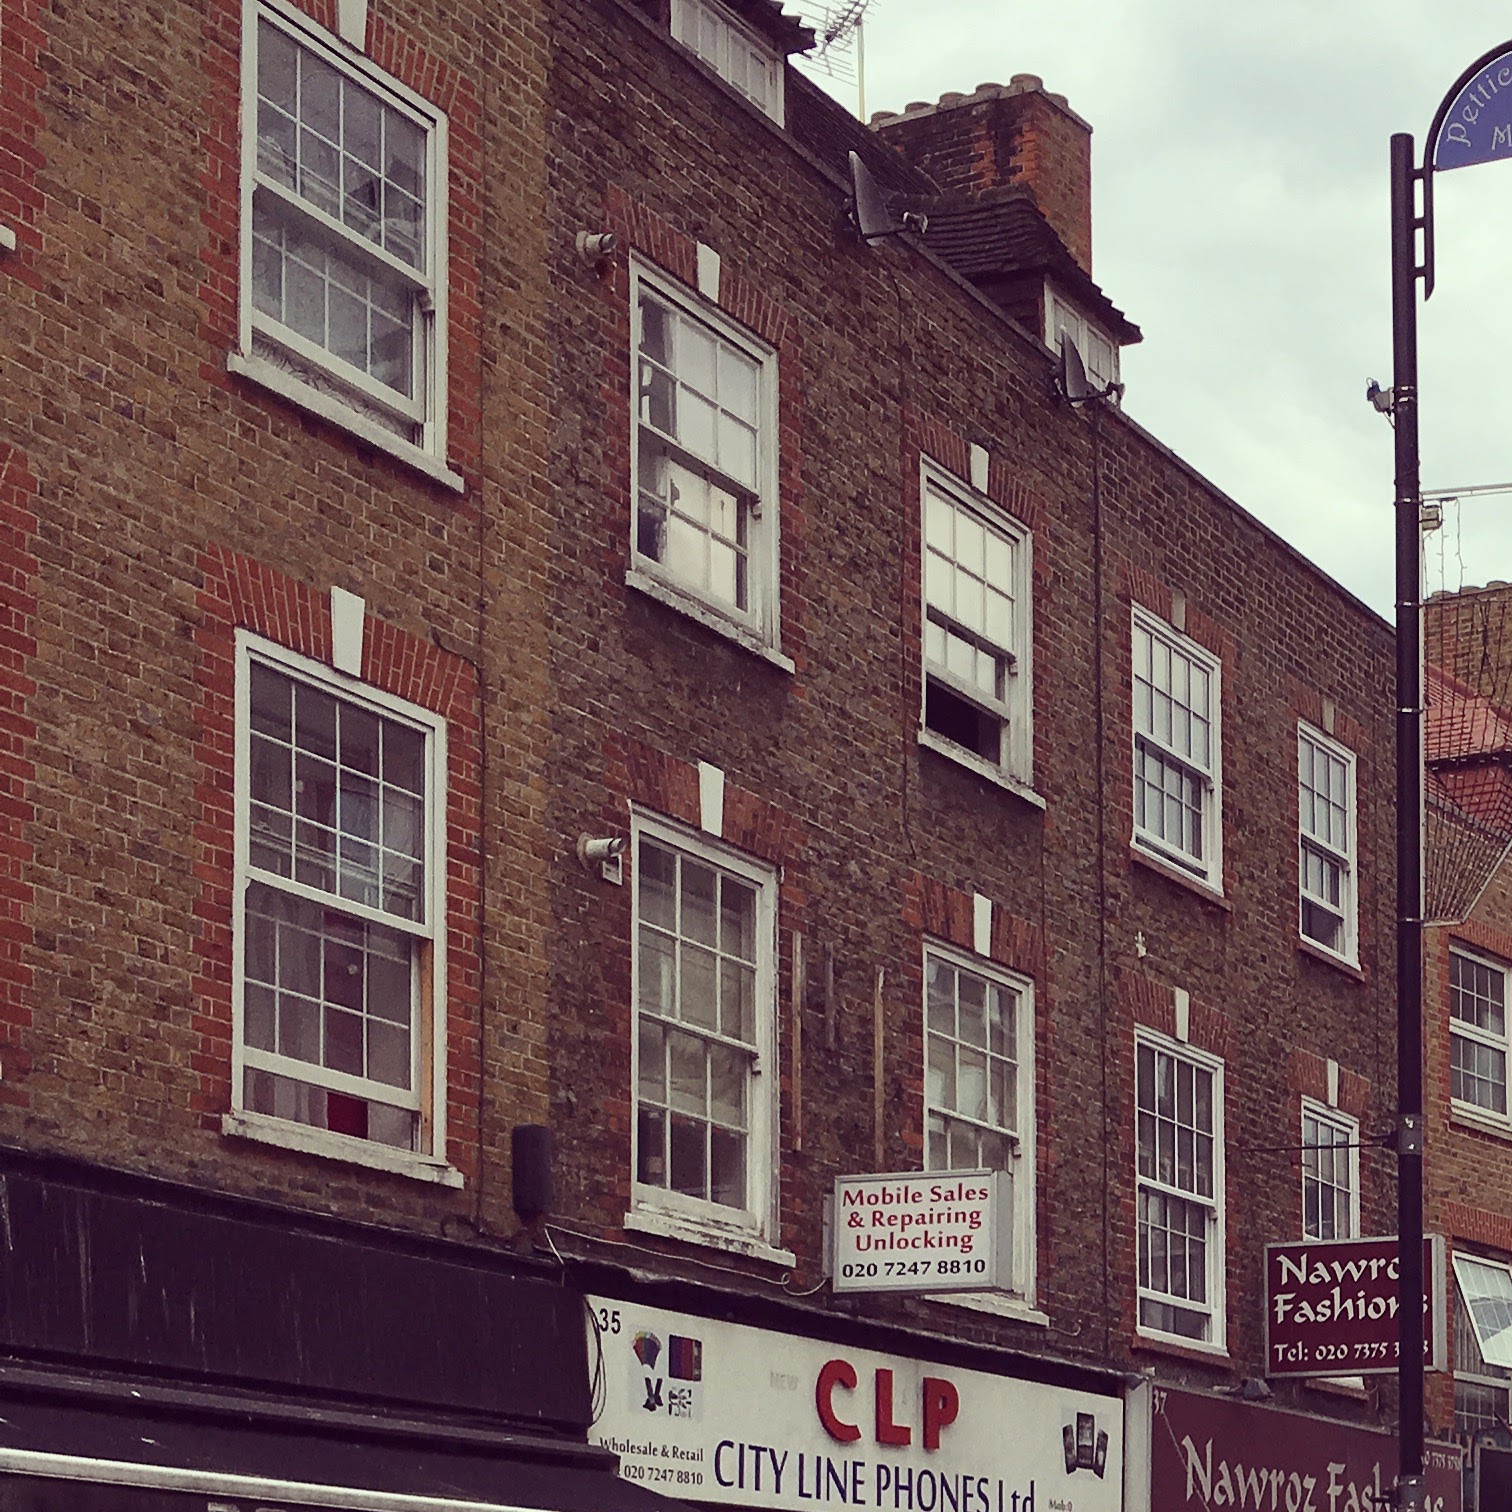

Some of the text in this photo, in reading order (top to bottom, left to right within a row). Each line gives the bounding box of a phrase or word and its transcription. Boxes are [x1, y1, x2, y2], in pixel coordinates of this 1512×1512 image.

[842, 1182, 989, 1207] Mobile Sales
[847, 1206, 982, 1233] & Repairing
[855, 1230, 974, 1254] Unlocking
[842, 1258, 986, 1278] 020 7247 8810
[1275, 1252, 1400, 1286] Nawro
[599, 1307, 622, 1335] 35
[1273, 1341, 1309, 1363] Tel:
[1315, 1345, 1349, 1361] 020
[1353, 1342, 1389, 1360] 7375
[814, 1359, 960, 1450] CLP
[1153, 1388, 1168, 1414] 37
[599, 1436, 704, 1462] Wholesale & Retail
[623, 1465, 704, 1486] 020 7247 8810
[713, 1439, 789, 1494] CITY
[798, 1452, 866, 1505] LINE
